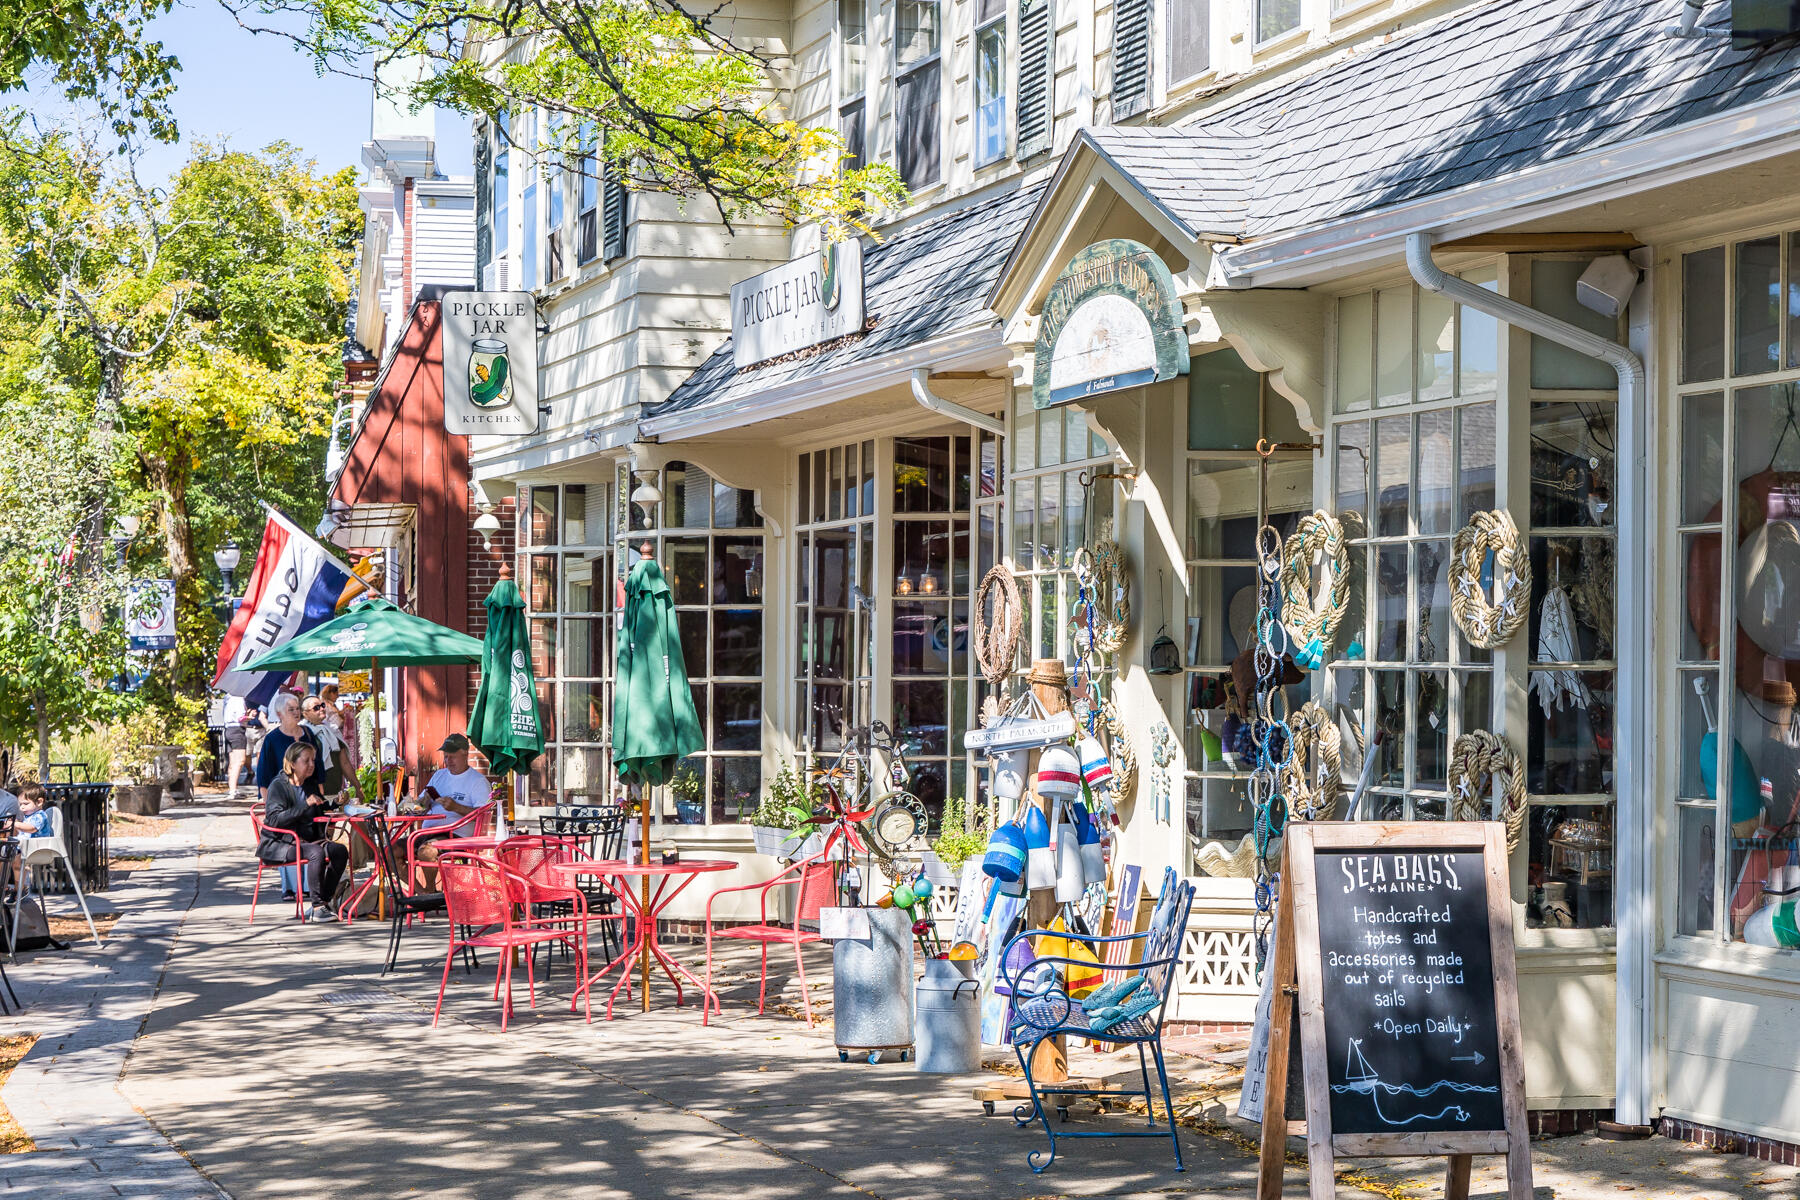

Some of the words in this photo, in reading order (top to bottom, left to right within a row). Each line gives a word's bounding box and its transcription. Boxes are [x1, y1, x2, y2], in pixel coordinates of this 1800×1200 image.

[742, 281, 791, 328] PICKLE
[794, 270, 821, 319] JAR
[452, 302, 526, 317] PICKLE
[470, 319, 507, 336] JAR
[783, 315, 846, 345] KITCHEN
[462, 415, 521, 423] KITCHEN
[972, 731, 1006, 743] NORTH
[1341, 856, 1386, 893] SEA
[1394, 854, 1459, 891] BAGS
[1377, 882, 1425, 893] MAINE
[1353, 904, 1451, 924] Handcrafted
[1365, 930, 1402, 947] totes
[1413, 928, 1437, 944] and
[1328, 951, 1416, 966] accessories
[1426, 951, 1463, 966] made
[1344, 971, 1369, 984] out
[1378, 969, 1395, 984] of
[1402, 970, 1464, 994] recycled
[1374, 989, 1406, 1007] sails
[1383, 1018, 1421, 1041] Open
[1426, 1015, 1462, 1044] Daily
